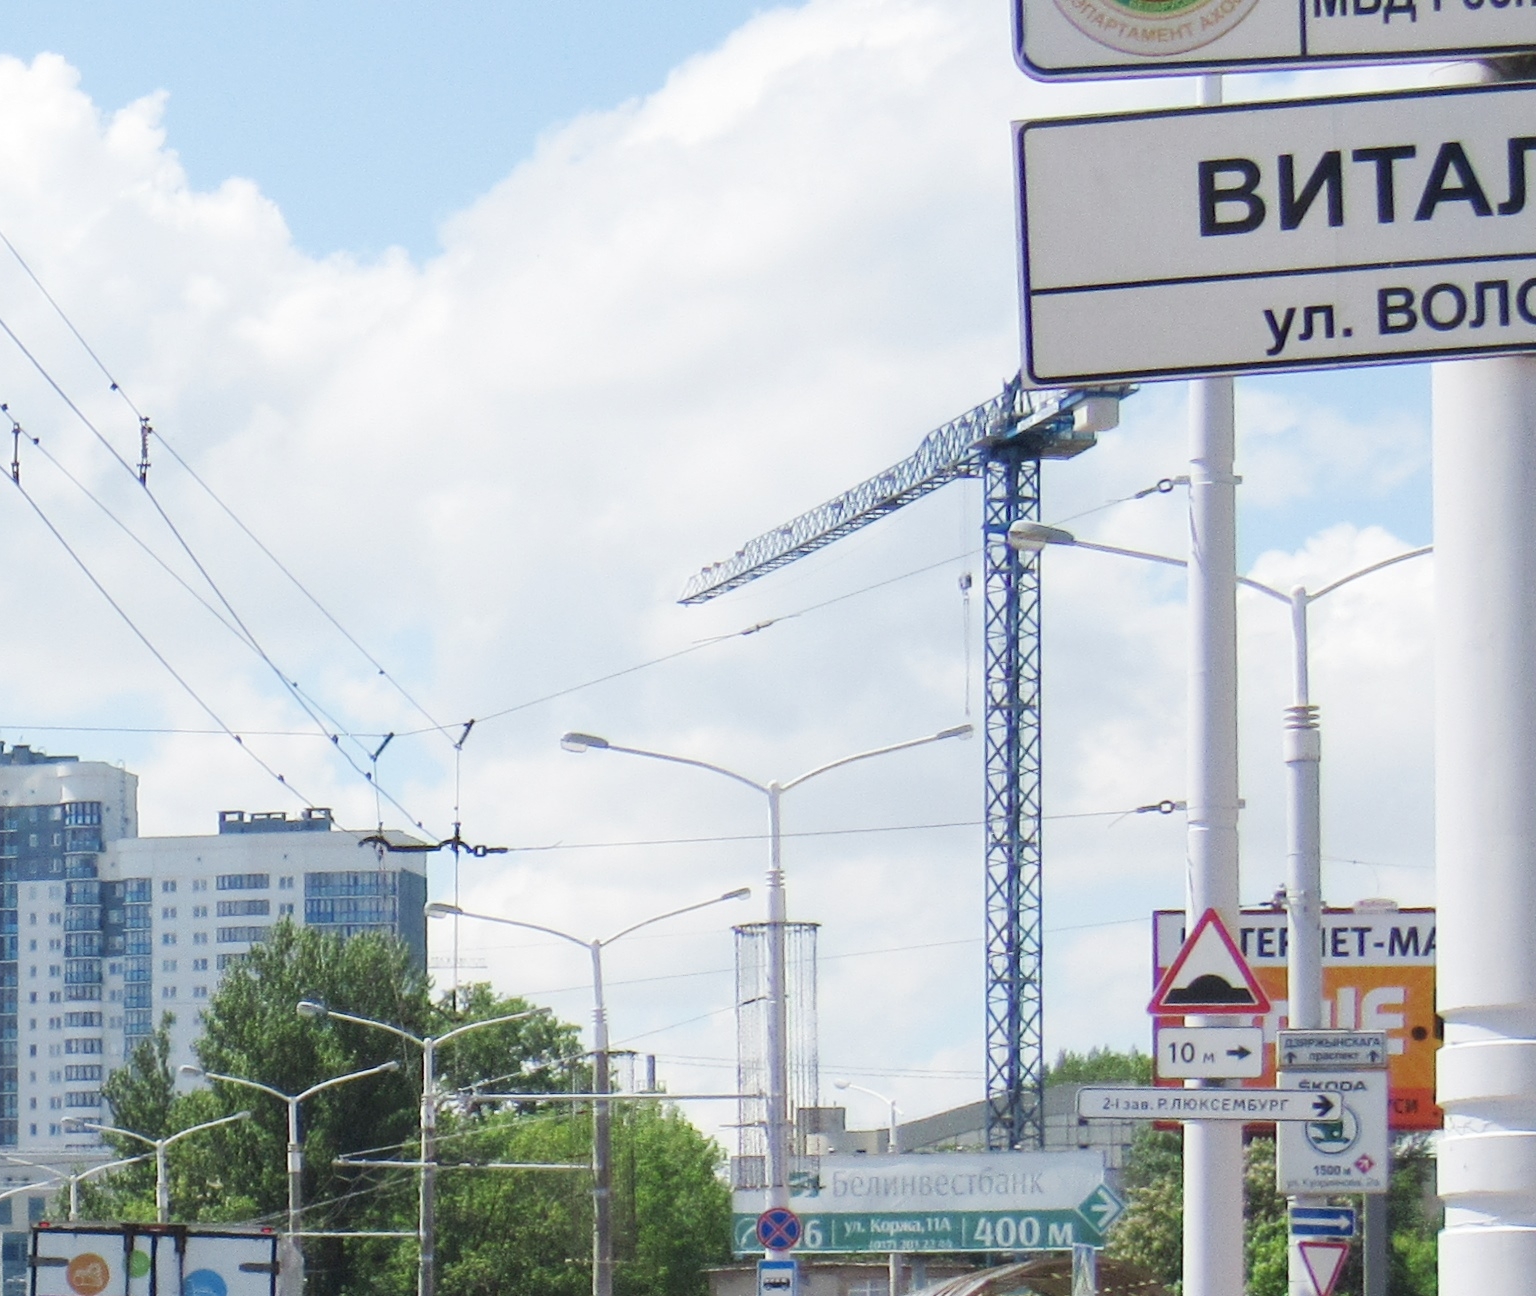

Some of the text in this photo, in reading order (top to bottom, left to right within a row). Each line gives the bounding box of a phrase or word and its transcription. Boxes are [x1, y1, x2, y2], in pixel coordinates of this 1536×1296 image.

[1264, 304, 1353, 356] ул.
[1168, 1042, 1195, 1063] 10
[831, 1168, 1045, 1198] Белинвестбанк
[797, 1219, 823, 1249] 6
[844, 1220, 866, 1238] ул.
[974, 1216, 1040, 1247] 400
